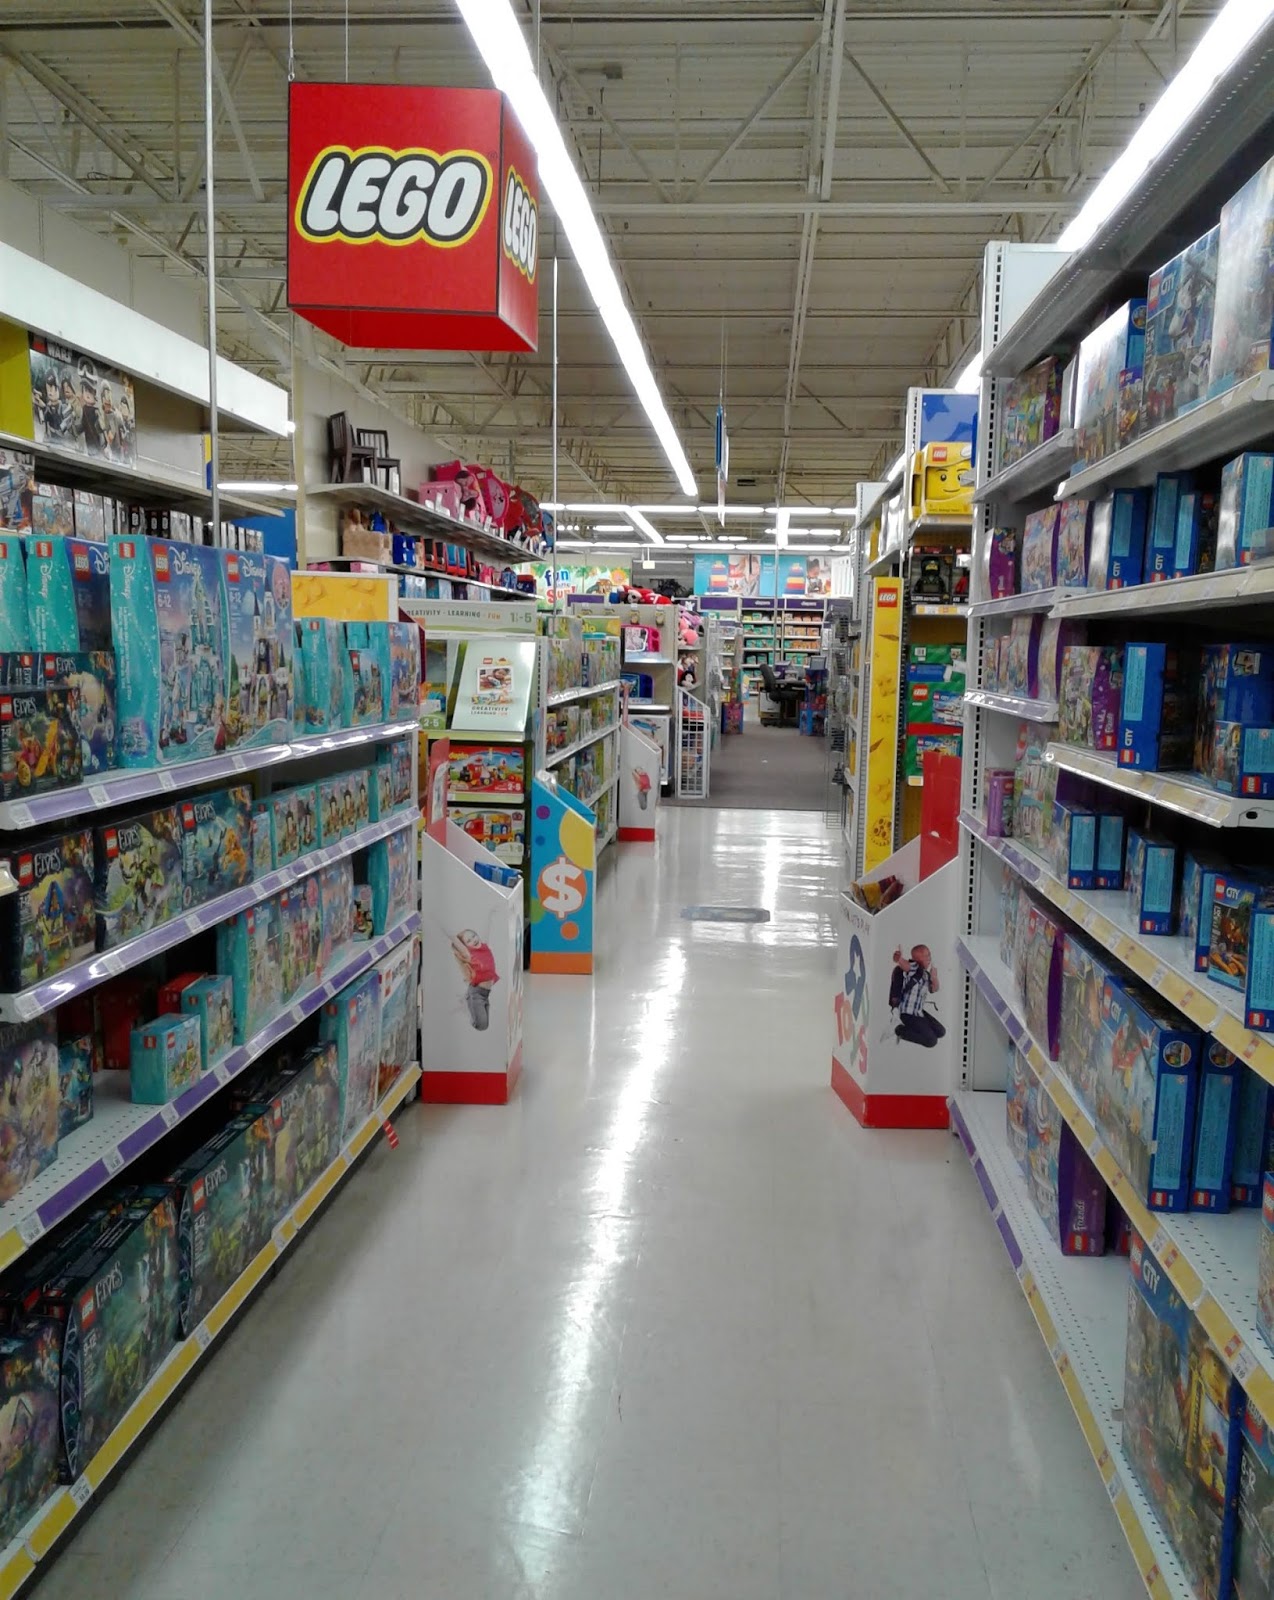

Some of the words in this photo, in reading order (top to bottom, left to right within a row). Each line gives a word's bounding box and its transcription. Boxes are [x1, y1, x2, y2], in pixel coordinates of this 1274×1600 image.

[301, 151, 488, 242] LEGO
[503, 172, 537, 279] LEGO
[169, 546, 202, 577] Disney
[238, 556, 266, 581] Disney
[879, 593, 896, 603] LEGO
[447, 610, 481, 618] LEARNING
[913, 688, 928, 696] LEGO
[1124, 728, 1133, 747] CITY
[1226, 886, 1241, 900] CITY
